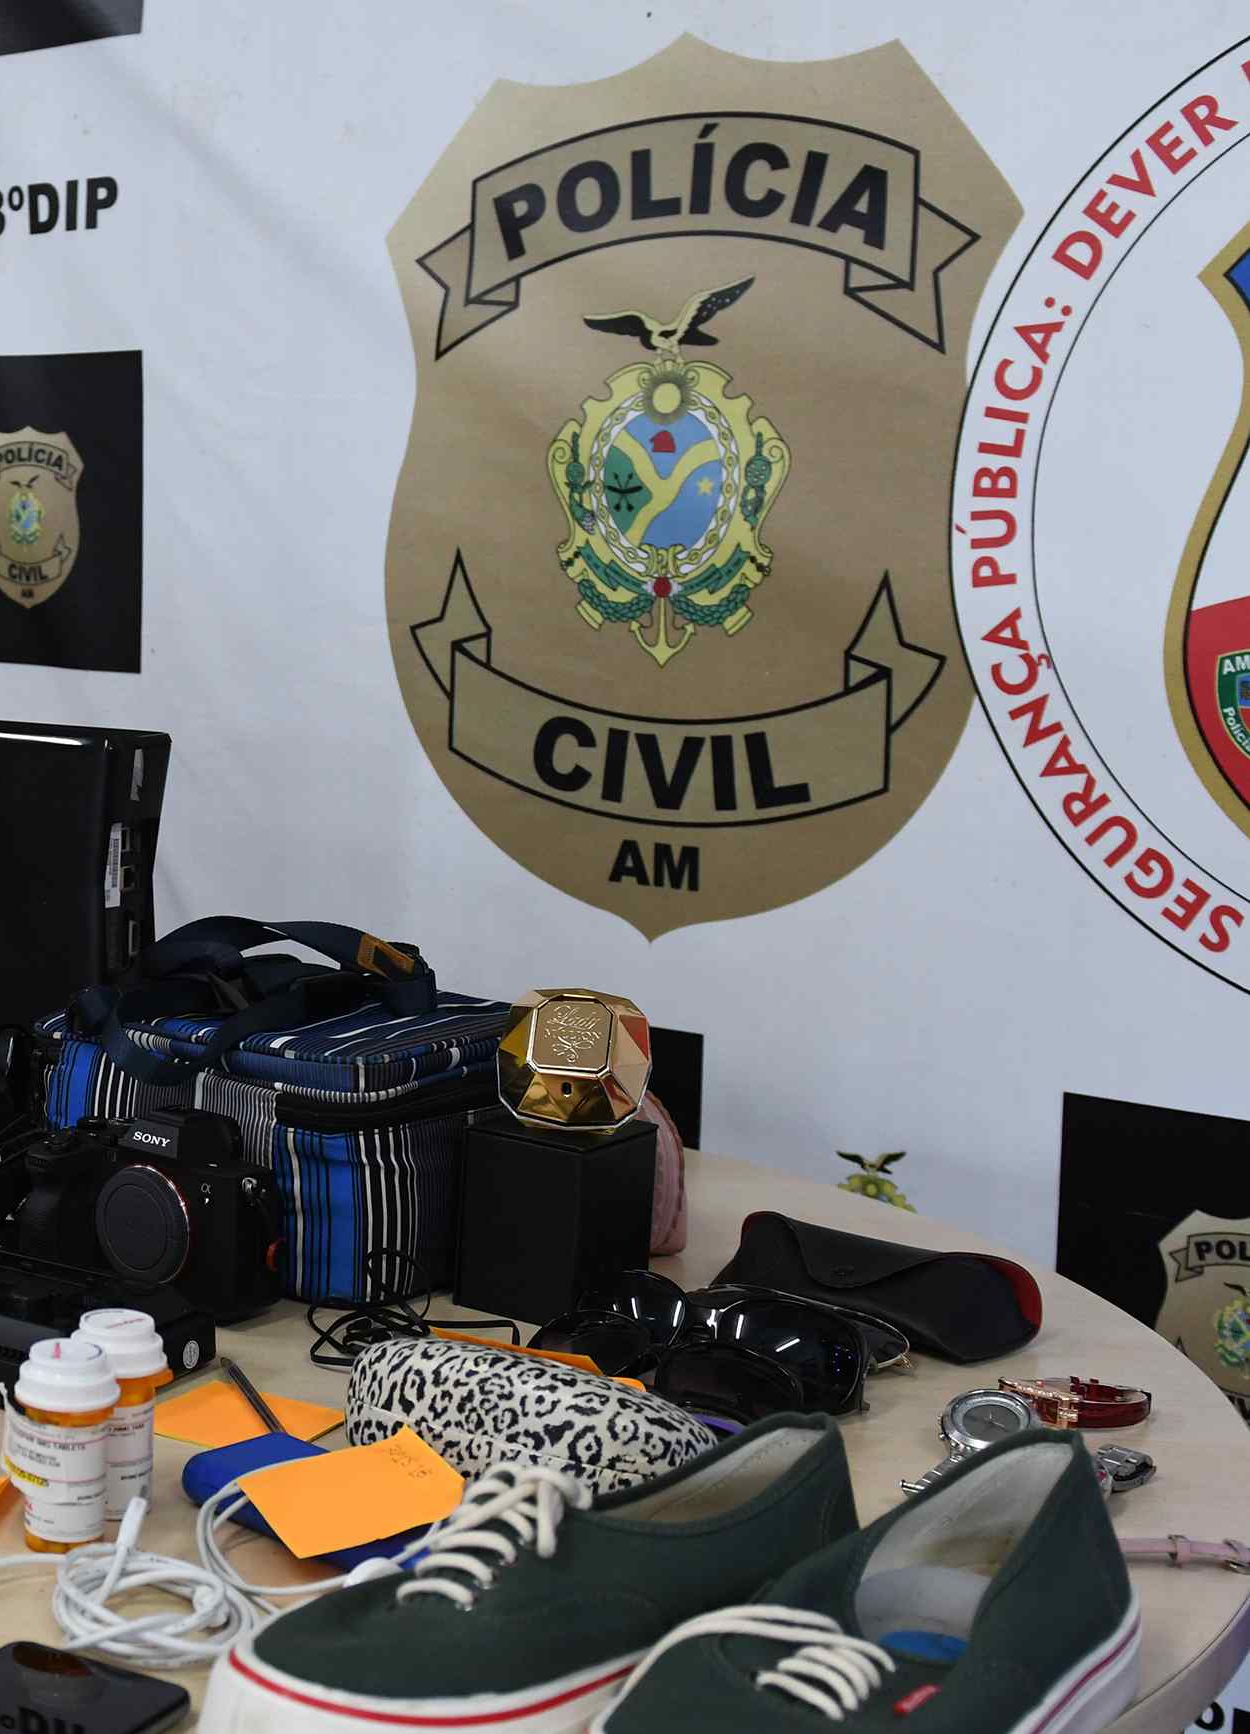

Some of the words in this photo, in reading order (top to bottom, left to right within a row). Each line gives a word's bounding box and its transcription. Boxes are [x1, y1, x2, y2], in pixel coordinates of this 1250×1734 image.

[492, 123, 892, 261] POLÍCIA
[1053, 94, 1238, 281] DEVER
[956, 296, 1073, 589] PÚBLICA:
[8, 564, 47, 581] CIVIL
[533, 716, 811, 811] CIVIL
[982, 608, 1244, 954] SEGURANÇA
[607, 839, 701, 892] AM
[133, 1130, 171, 1147] SONY
